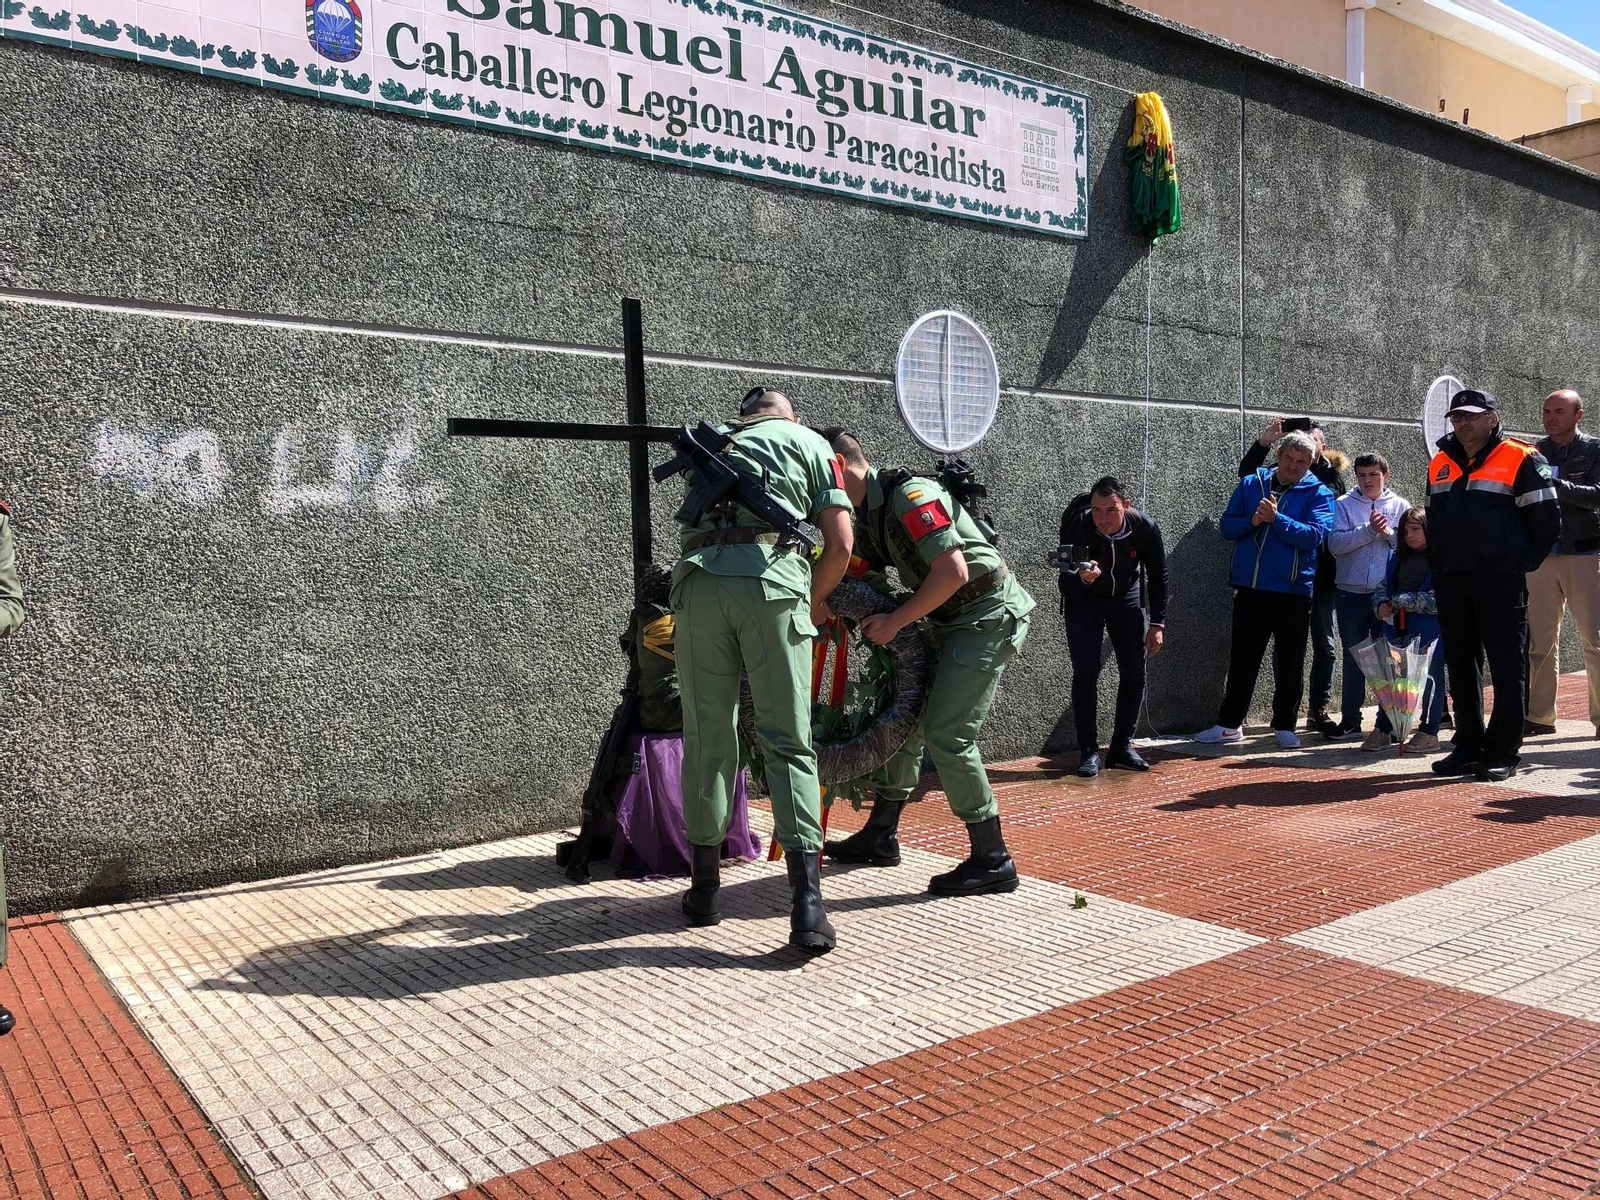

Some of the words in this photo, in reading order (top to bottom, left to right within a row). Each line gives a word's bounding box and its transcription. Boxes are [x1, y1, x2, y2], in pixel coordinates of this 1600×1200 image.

[385, 21, 606, 109] Caballero
[616, 72, 816, 153] Legionario
[825, 120, 1007, 194] Paracaidista
[763, 45, 986, 139] Aguilar
[1021, 168, 1060, 184] Ayuntamiento
[1021, 177, 1033, 187] Los
[1036, 180, 1060, 192] Barrios
